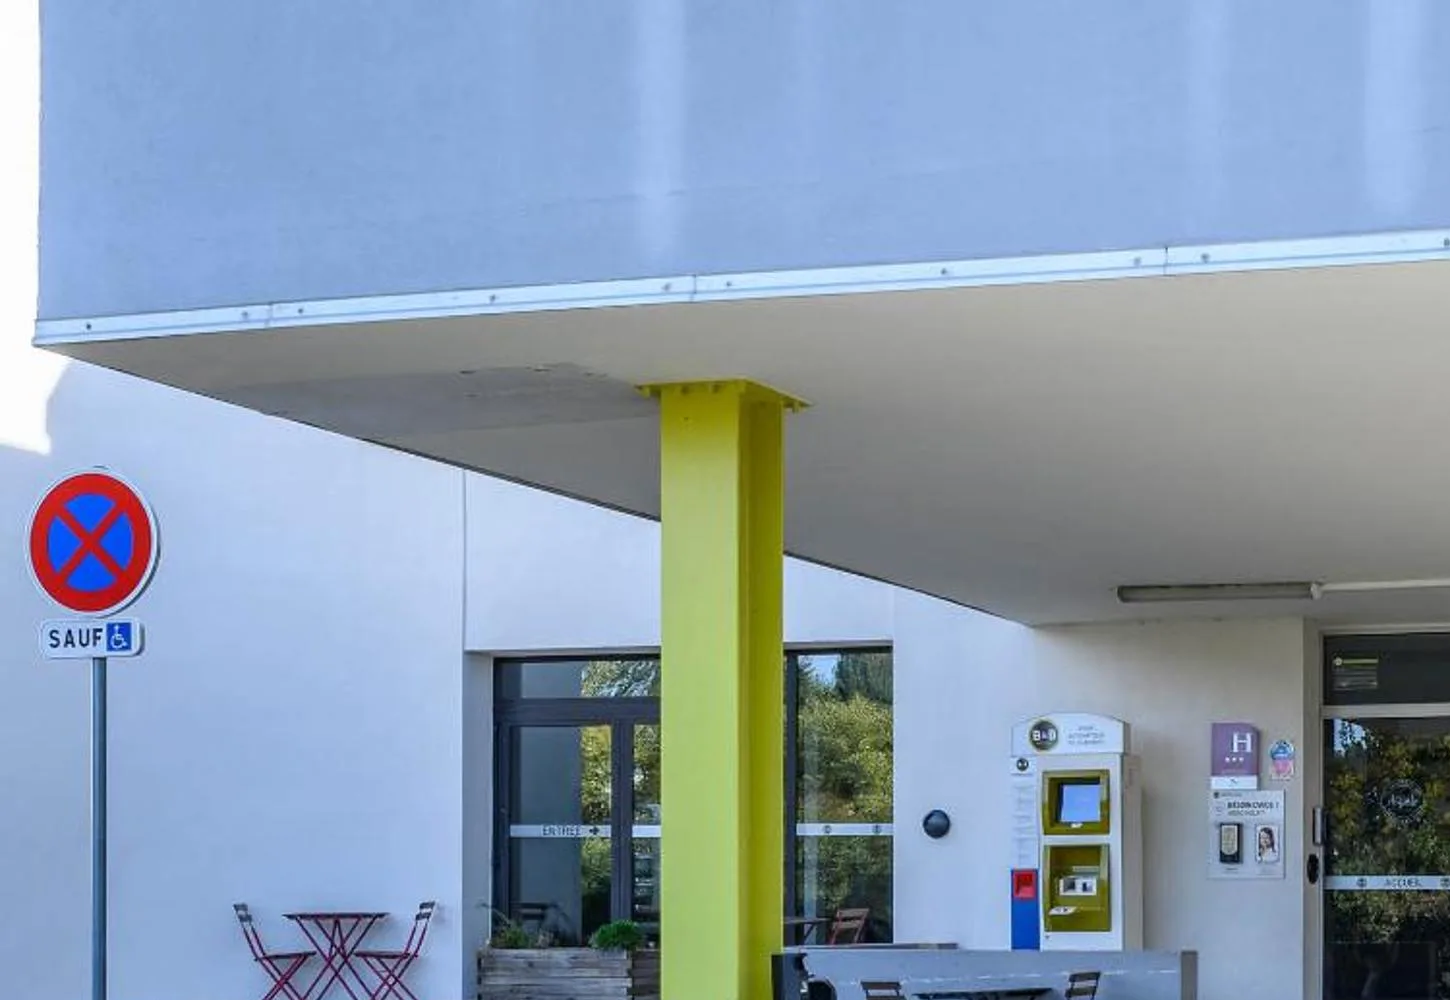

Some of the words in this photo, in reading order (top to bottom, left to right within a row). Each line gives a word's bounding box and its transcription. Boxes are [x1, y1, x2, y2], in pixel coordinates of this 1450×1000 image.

[49, 628, 104, 649] SAUF
[1232, 732, 1253, 753] H
[1384, 877, 1421, 888] ACCUEIL
